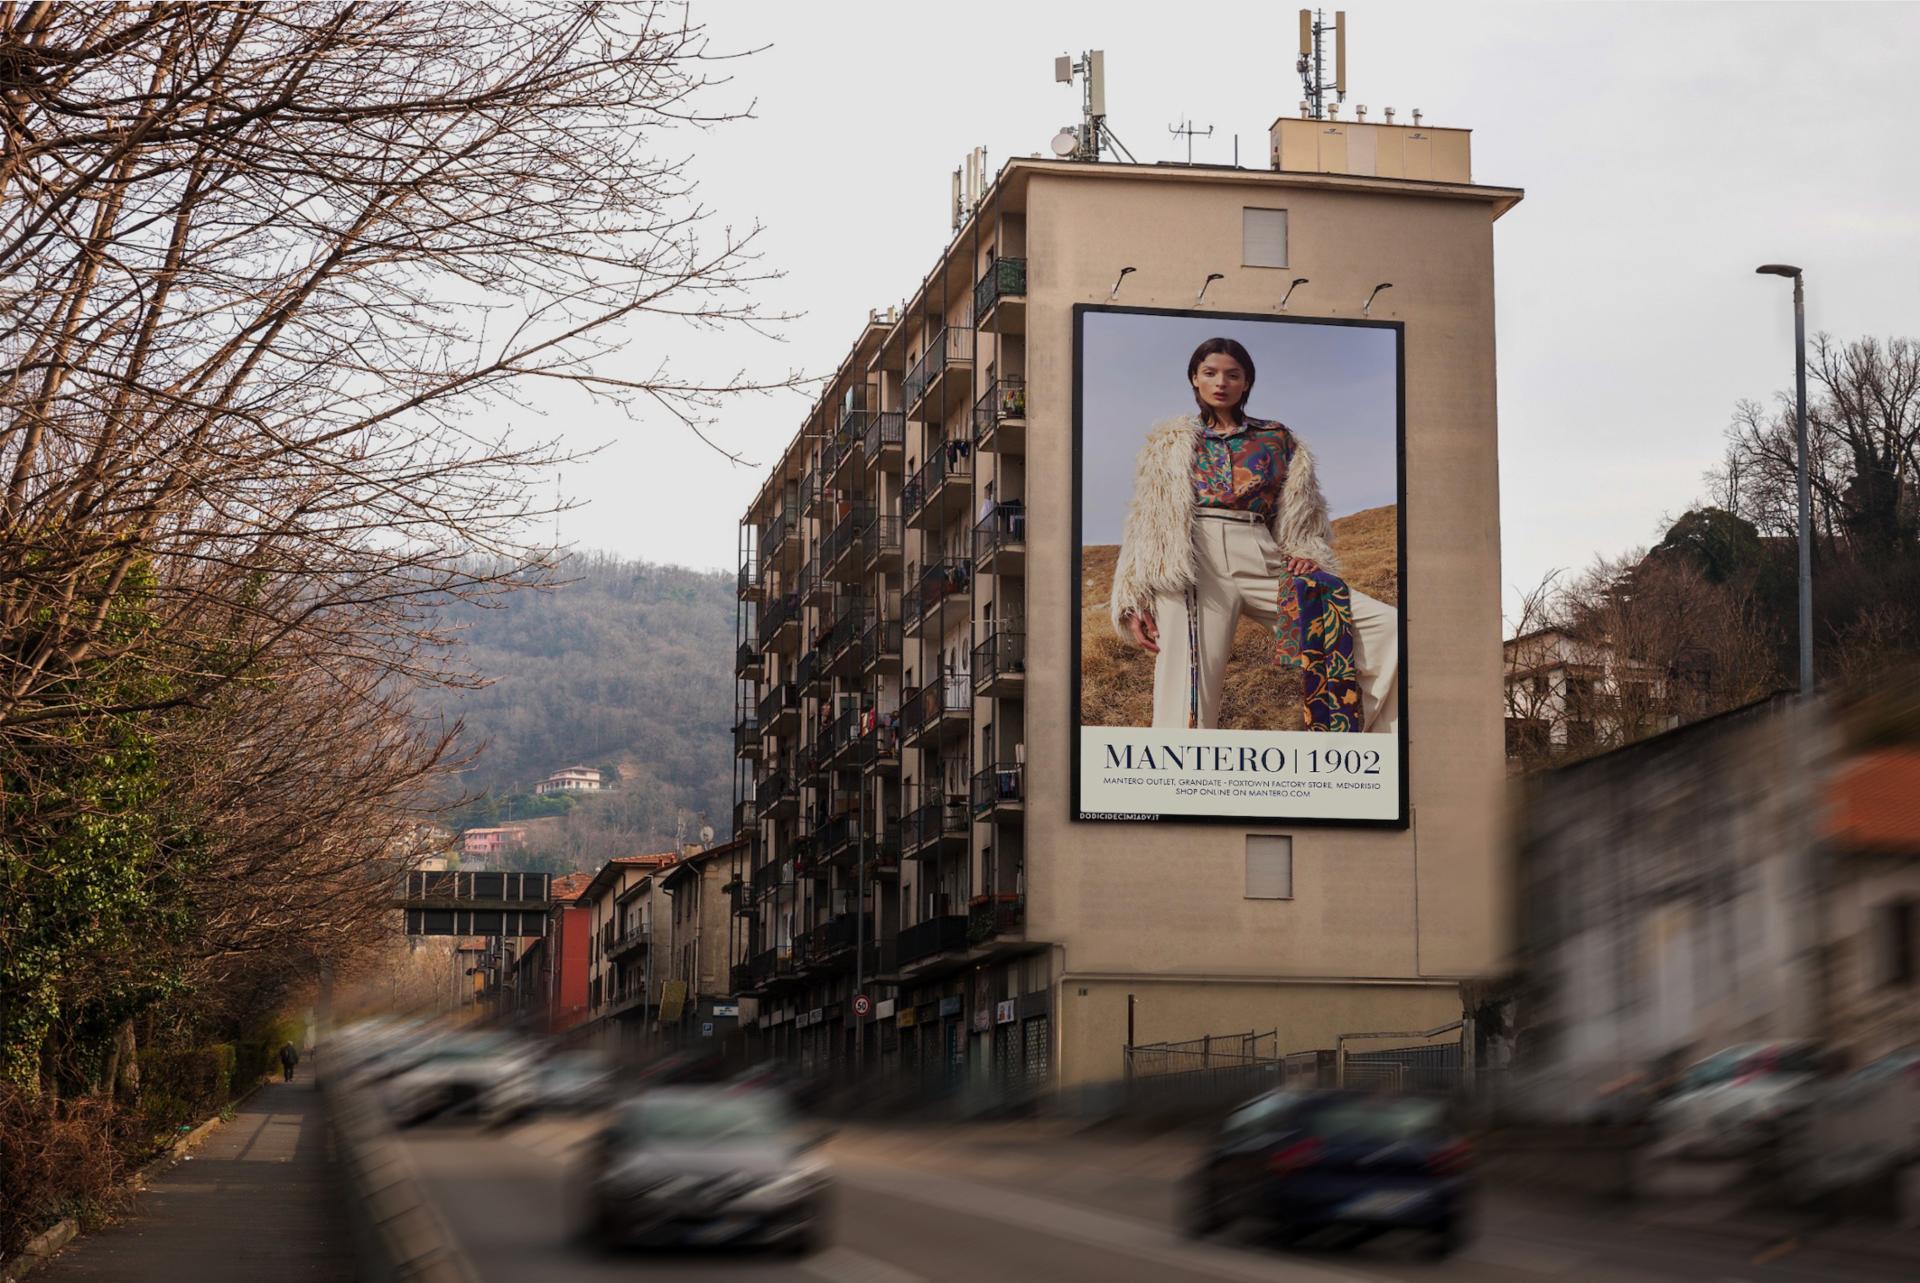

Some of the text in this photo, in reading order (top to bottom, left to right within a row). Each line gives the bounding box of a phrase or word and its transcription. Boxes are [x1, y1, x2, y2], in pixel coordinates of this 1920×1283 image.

[1104, 744, 1285, 773] MANTERO
[1306, 749, 1381, 774] 1902
[1103, 777, 1144, 785] MANTERO
[1179, 779, 1222, 787] GRANDATE
[1228, 780, 1270, 788] FOXTOWN
[1271, 780, 1306, 788] FACTORY
[1336, 782, 1381, 790] MENDRISIO
[1175, 788, 1198, 796] SHOP
[1199, 788, 1230, 796] ONLINE
[857, 1001, 866, 1010] 50
